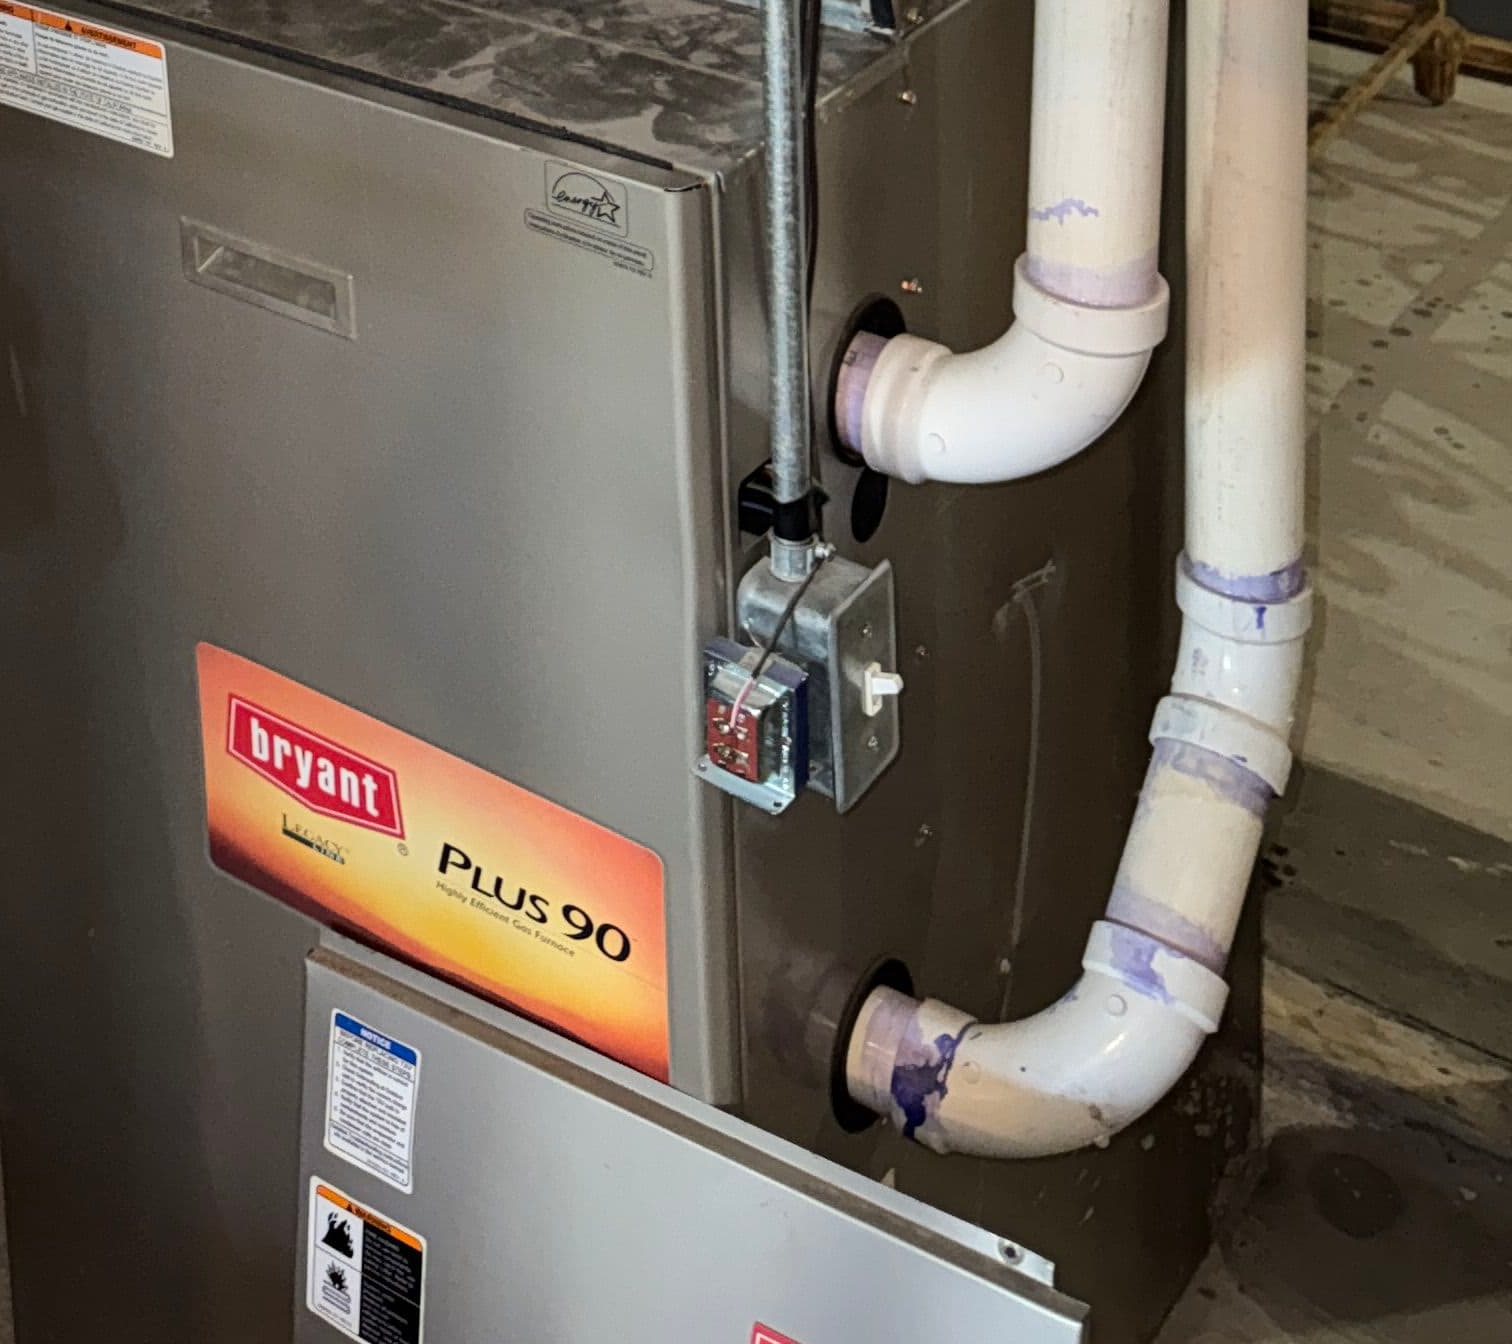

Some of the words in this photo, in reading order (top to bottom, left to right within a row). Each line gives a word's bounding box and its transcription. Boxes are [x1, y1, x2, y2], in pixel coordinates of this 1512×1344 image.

[250, 716, 380, 818] bryant
[436, 881, 468, 903] Highly
[469, 897, 510, 925] Efficient
[512, 919, 532, 937] Gas
[534, 928, 576, 957] Furnace
[438, 842, 550, 924] PLUS
[561, 904, 631, 962] 90
